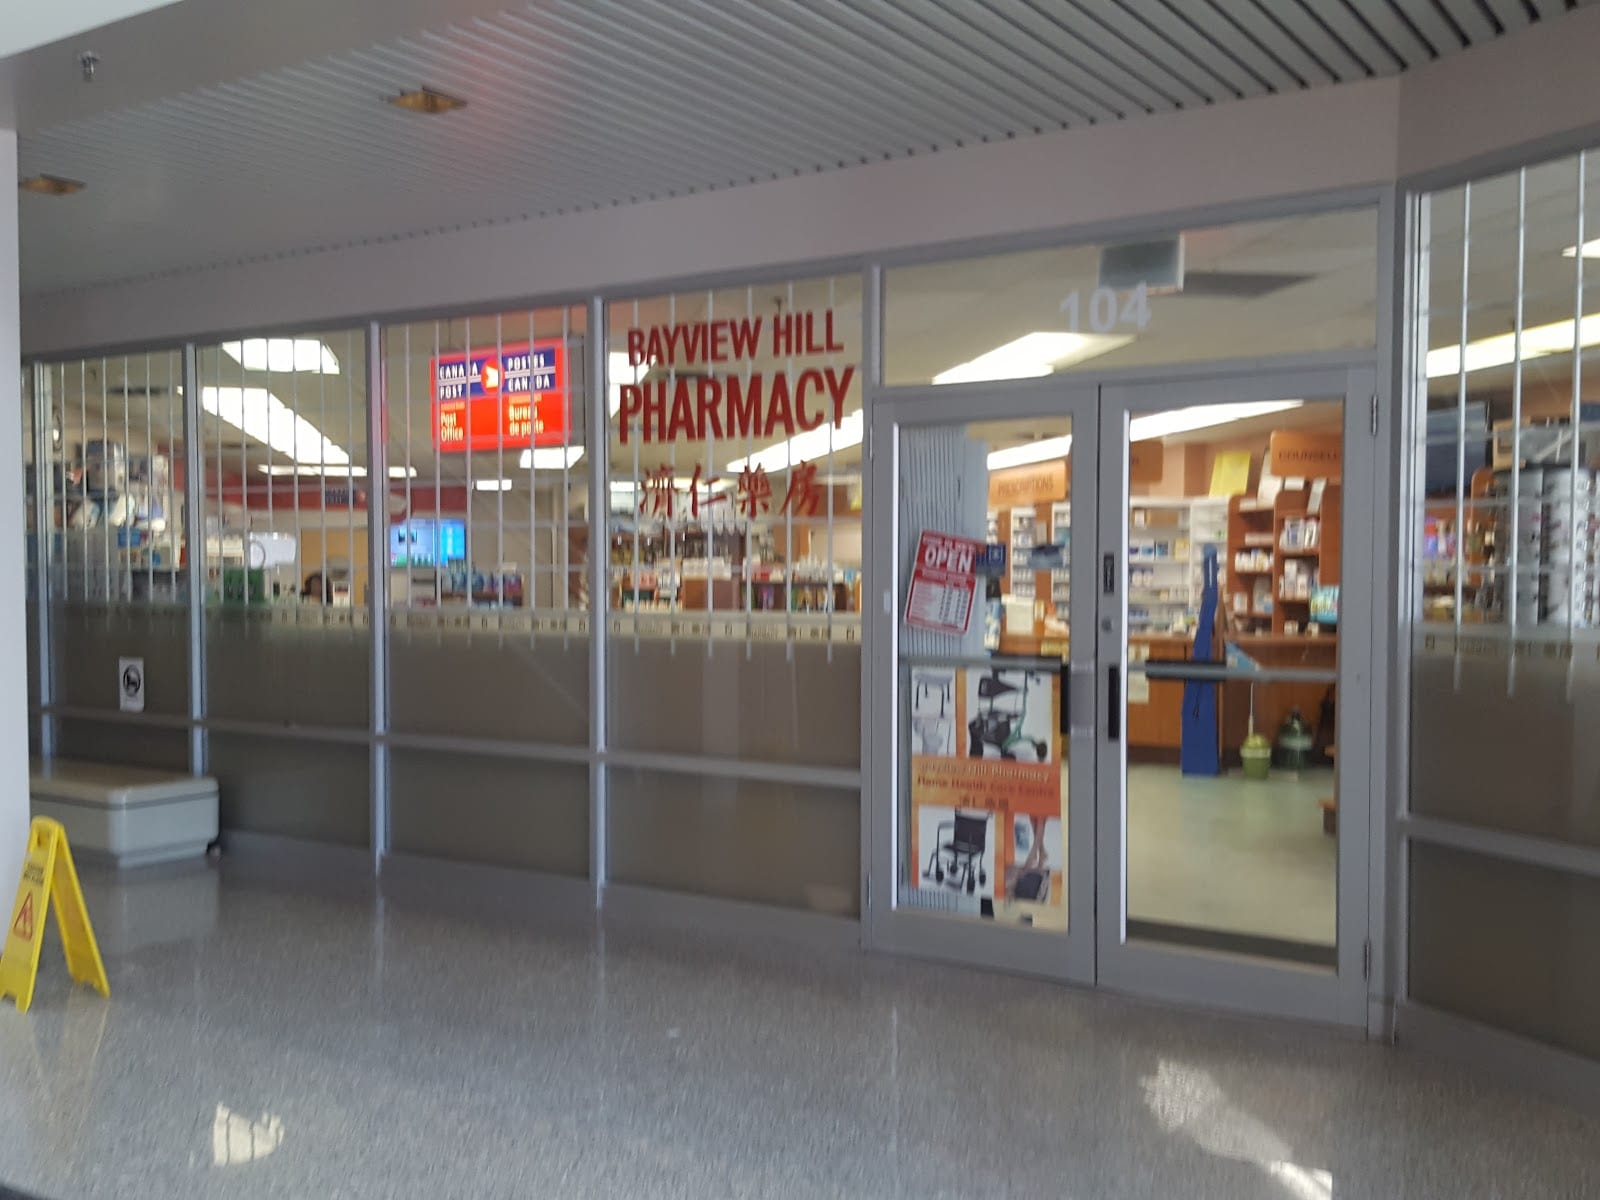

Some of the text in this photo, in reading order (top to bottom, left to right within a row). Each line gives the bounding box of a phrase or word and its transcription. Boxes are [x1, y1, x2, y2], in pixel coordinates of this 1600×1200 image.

[1059, 281, 1152, 334] 104
[628, 309, 844, 367] BAYVIEW HILL
[440, 362, 478, 380] CANAA
[619, 365, 855, 446] PHARMACY
[925, 542, 974, 574] OPEN
